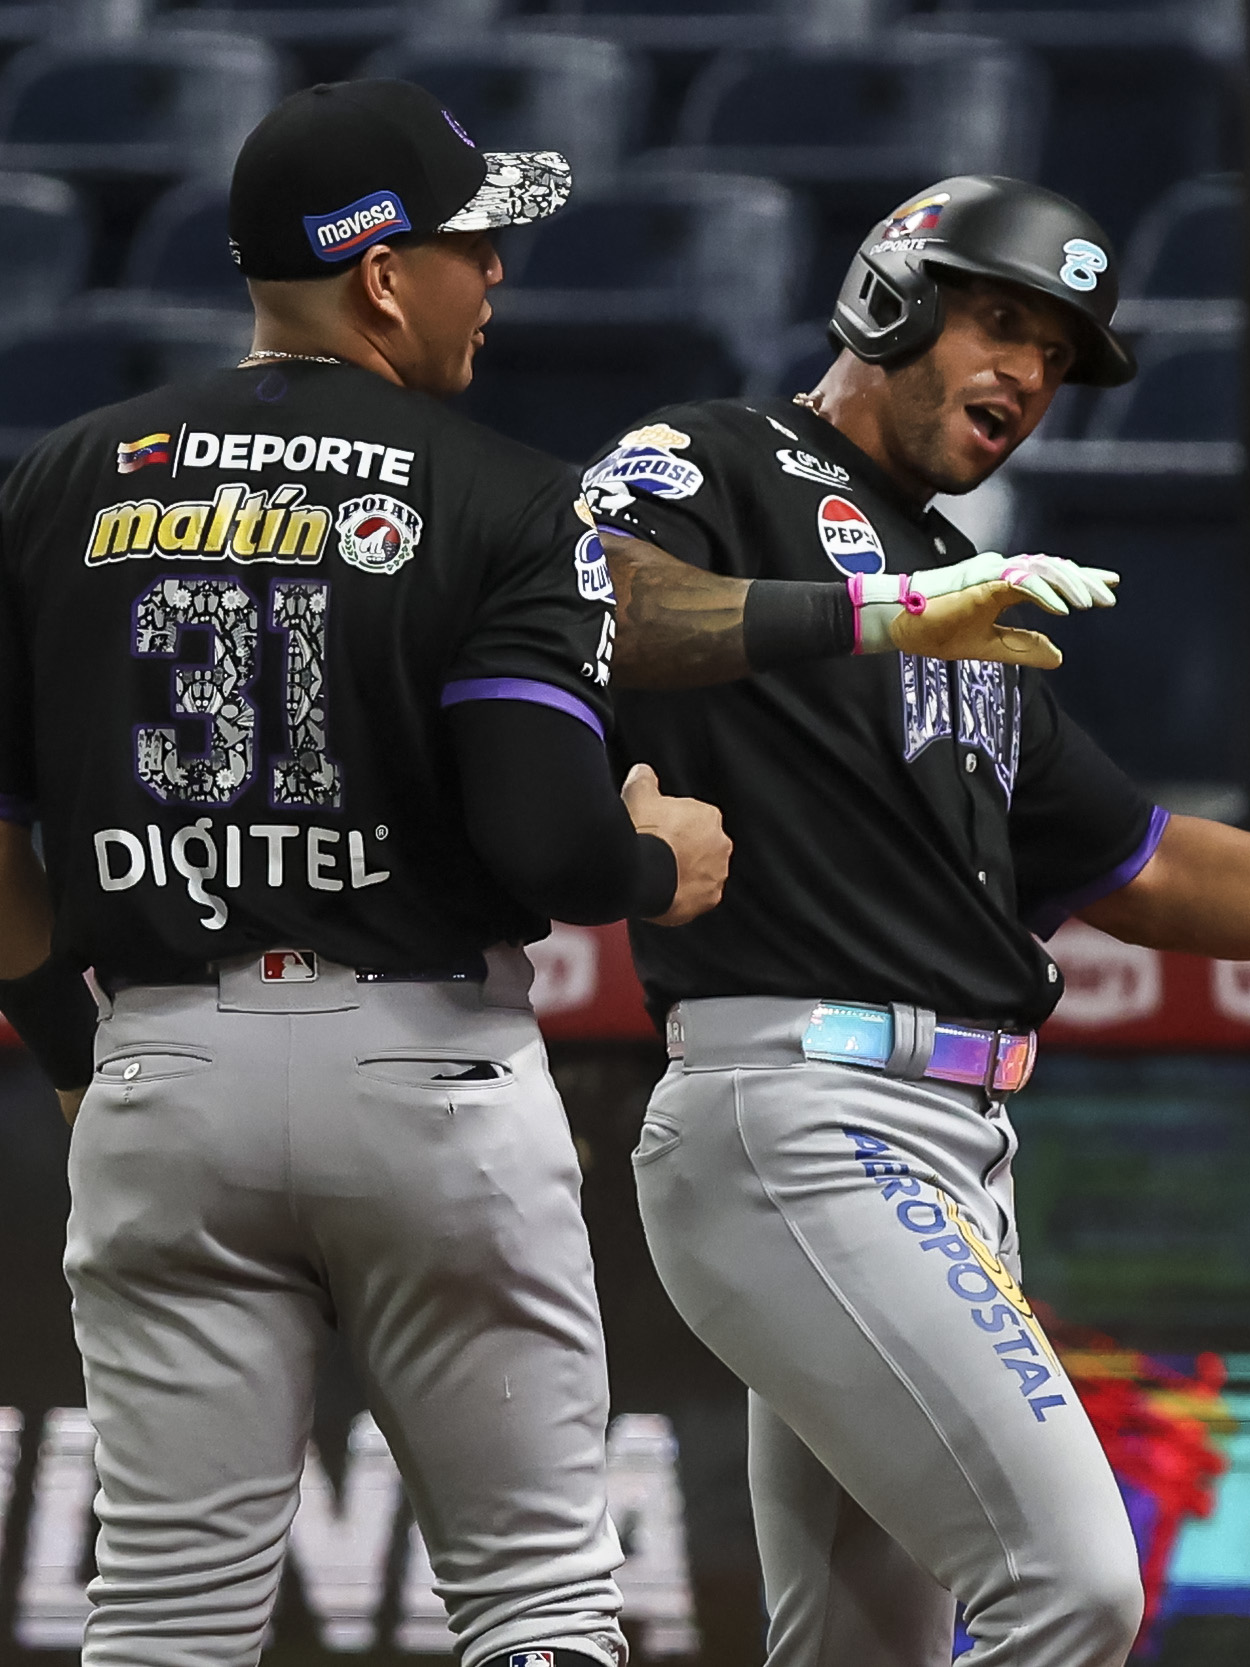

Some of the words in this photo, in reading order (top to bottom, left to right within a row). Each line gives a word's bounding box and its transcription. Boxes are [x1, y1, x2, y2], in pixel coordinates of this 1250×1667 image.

[317, 199, 396, 247] mavesa
[183, 432, 415, 486] DEPORTE
[87, 485, 331, 565] maltín
[339, 497, 420, 540] POLAR
[131, 574, 344, 810] 31
[843, 1128, 1067, 1422] AEROPOSTAL
